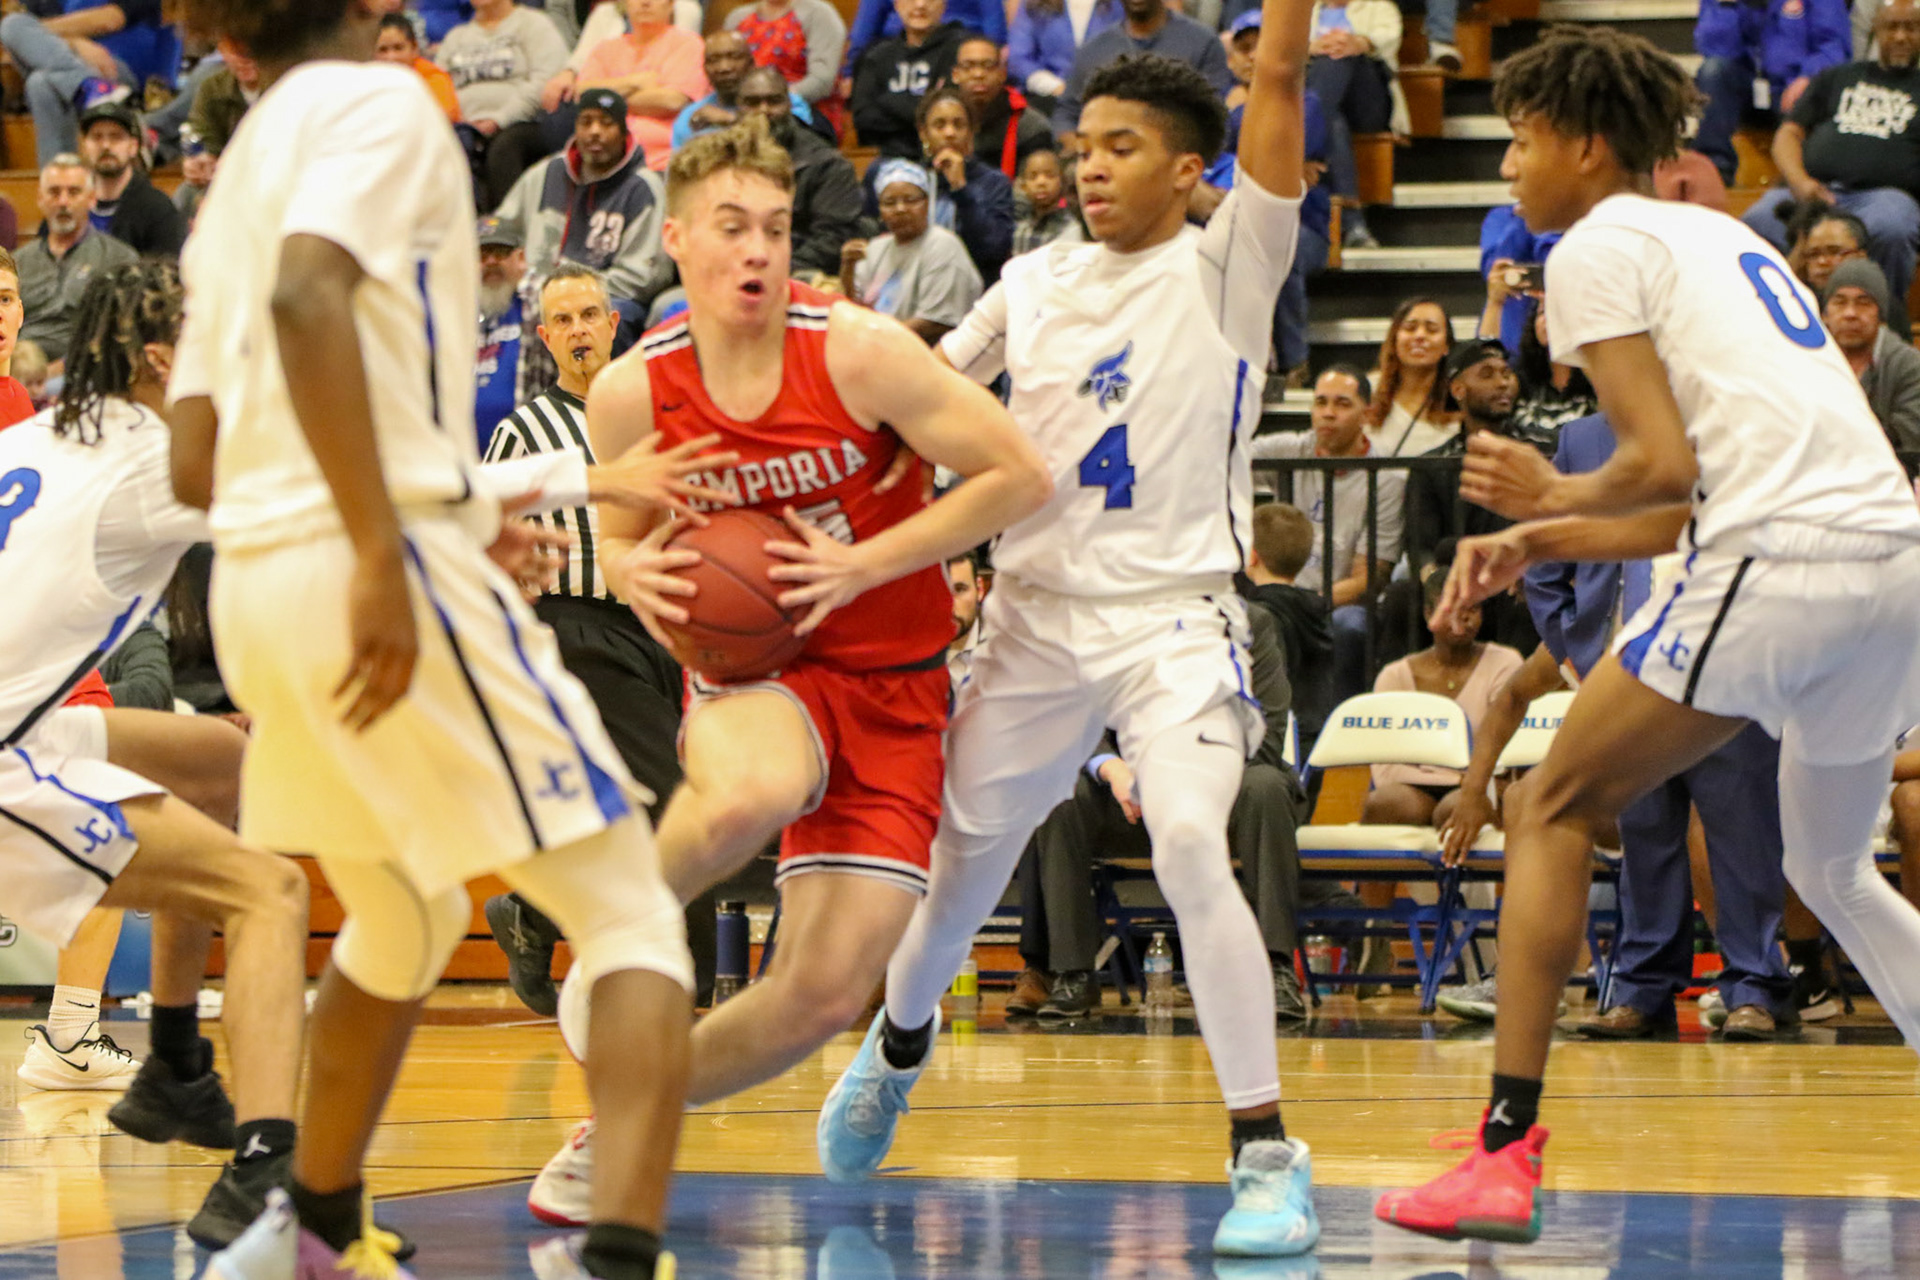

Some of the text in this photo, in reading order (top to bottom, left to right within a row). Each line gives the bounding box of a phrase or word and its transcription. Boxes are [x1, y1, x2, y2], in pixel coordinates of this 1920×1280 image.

[888, 61, 930, 93] JC
[586, 209, 625, 253] 23
[1739, 251, 1827, 348] 0
[1079, 423, 1136, 511] 4
[1342, 716, 1449, 730] BLUE JAYS
